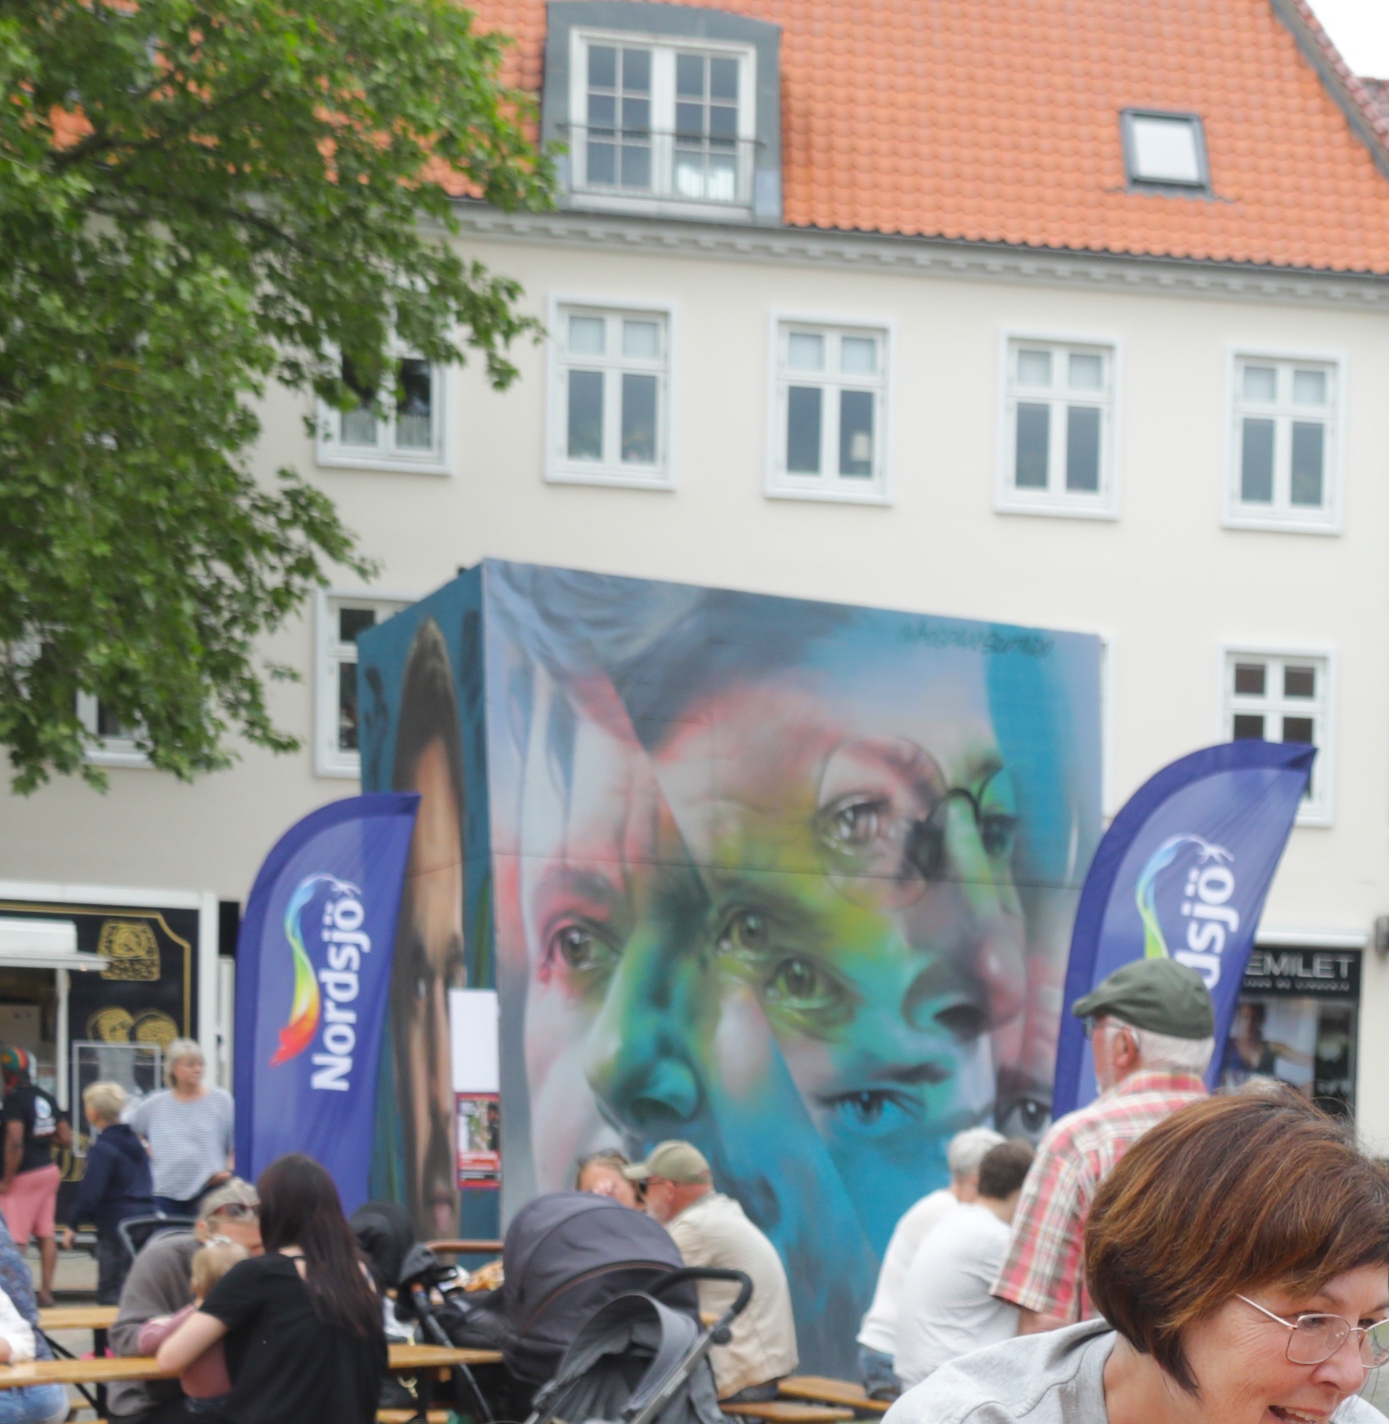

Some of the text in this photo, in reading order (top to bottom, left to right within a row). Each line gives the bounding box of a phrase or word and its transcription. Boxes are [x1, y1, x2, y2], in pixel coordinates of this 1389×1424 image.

[1174, 864, 1240, 991] dsjö
[1244, 951, 1355, 979] EMILET
[310, 897, 372, 1092] Nordsjö
